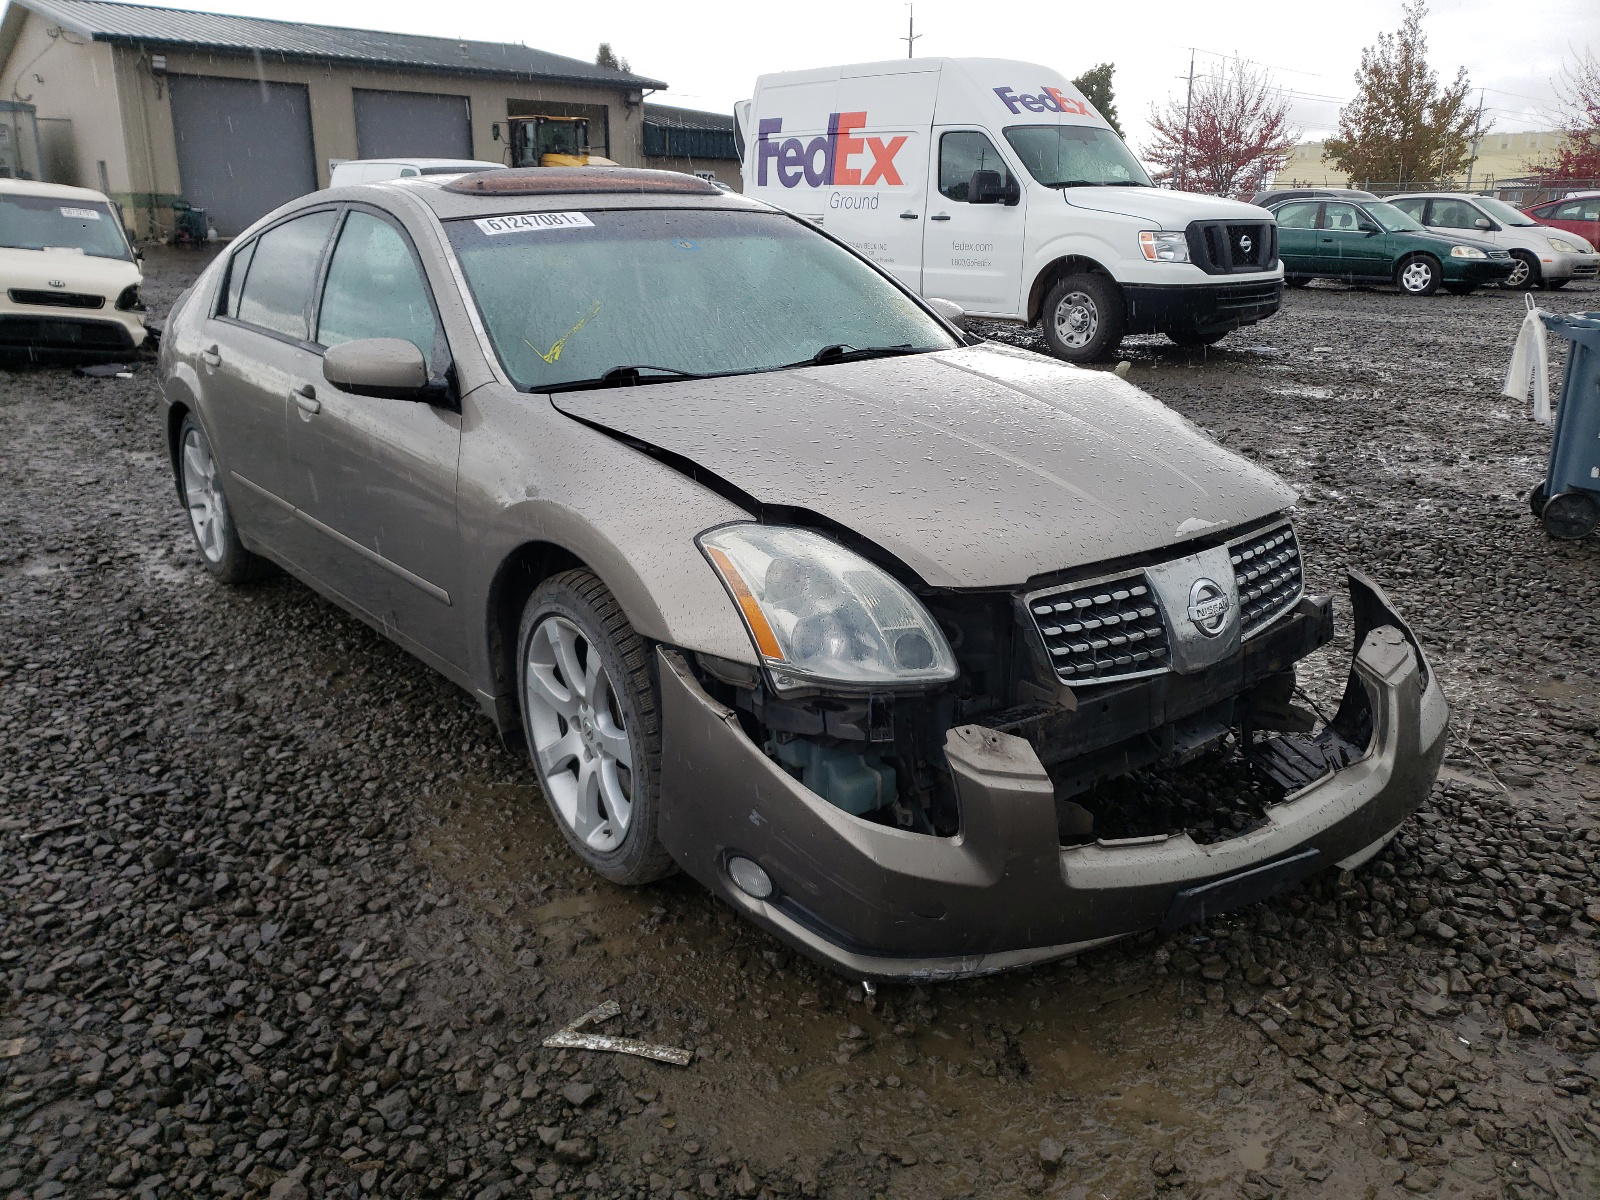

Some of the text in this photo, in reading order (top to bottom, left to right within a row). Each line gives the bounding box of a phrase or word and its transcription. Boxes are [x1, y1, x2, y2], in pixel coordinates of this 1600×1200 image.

[992, 86, 1097, 119] FedEx
[757, 111, 909, 189] FedEx
[829, 191, 880, 210] Ground
[486, 213, 573, 231] 61247081
[952, 241, 993, 252] fedex.com
[1196, 599, 1228, 618] NISSAN
